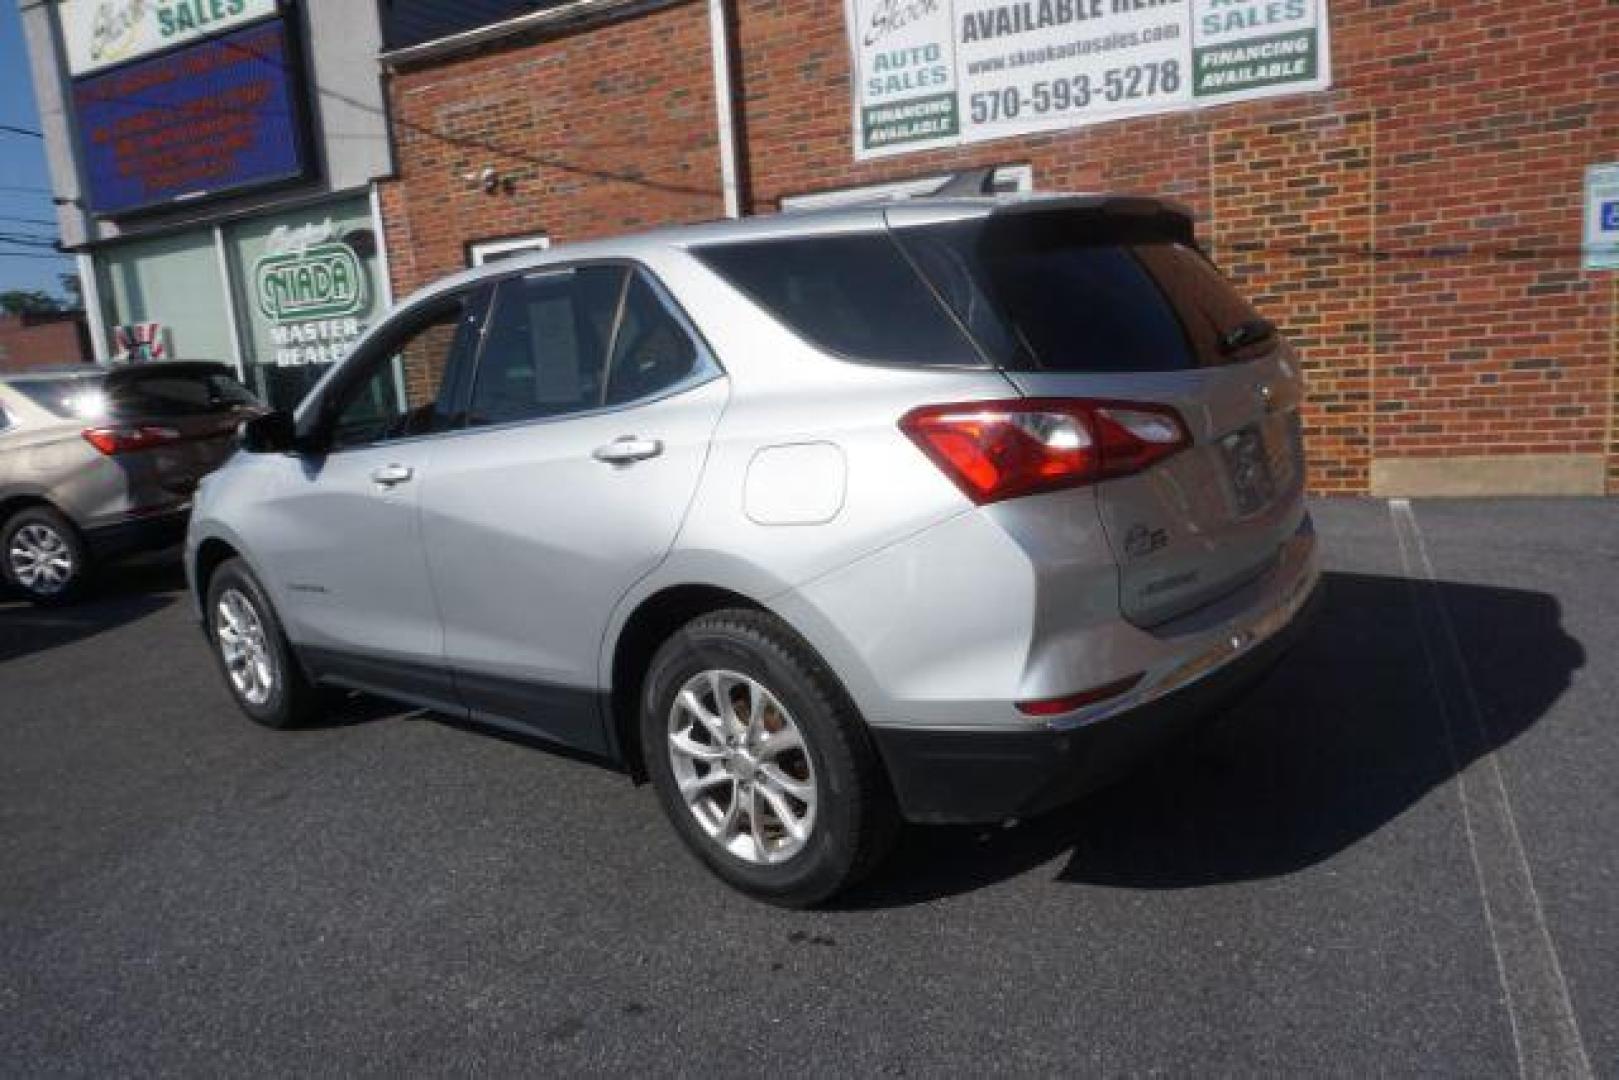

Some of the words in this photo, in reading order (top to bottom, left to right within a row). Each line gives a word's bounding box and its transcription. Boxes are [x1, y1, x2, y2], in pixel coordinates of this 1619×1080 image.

[960, 0, 1104, 44] AVAILABLE
[1201, 0, 1306, 35] SALES
[873, 42, 940, 74] AUTO
[1200, 37, 1309, 68] FINANCING
[867, 65, 948, 97] SALES
[1200, 57, 1307, 88] AVAILABLE
[969, 58, 1181, 125] 570-593-5278
[868, 97, 952, 125] FINANCING
[868, 117, 951, 143] AVAILABLE
